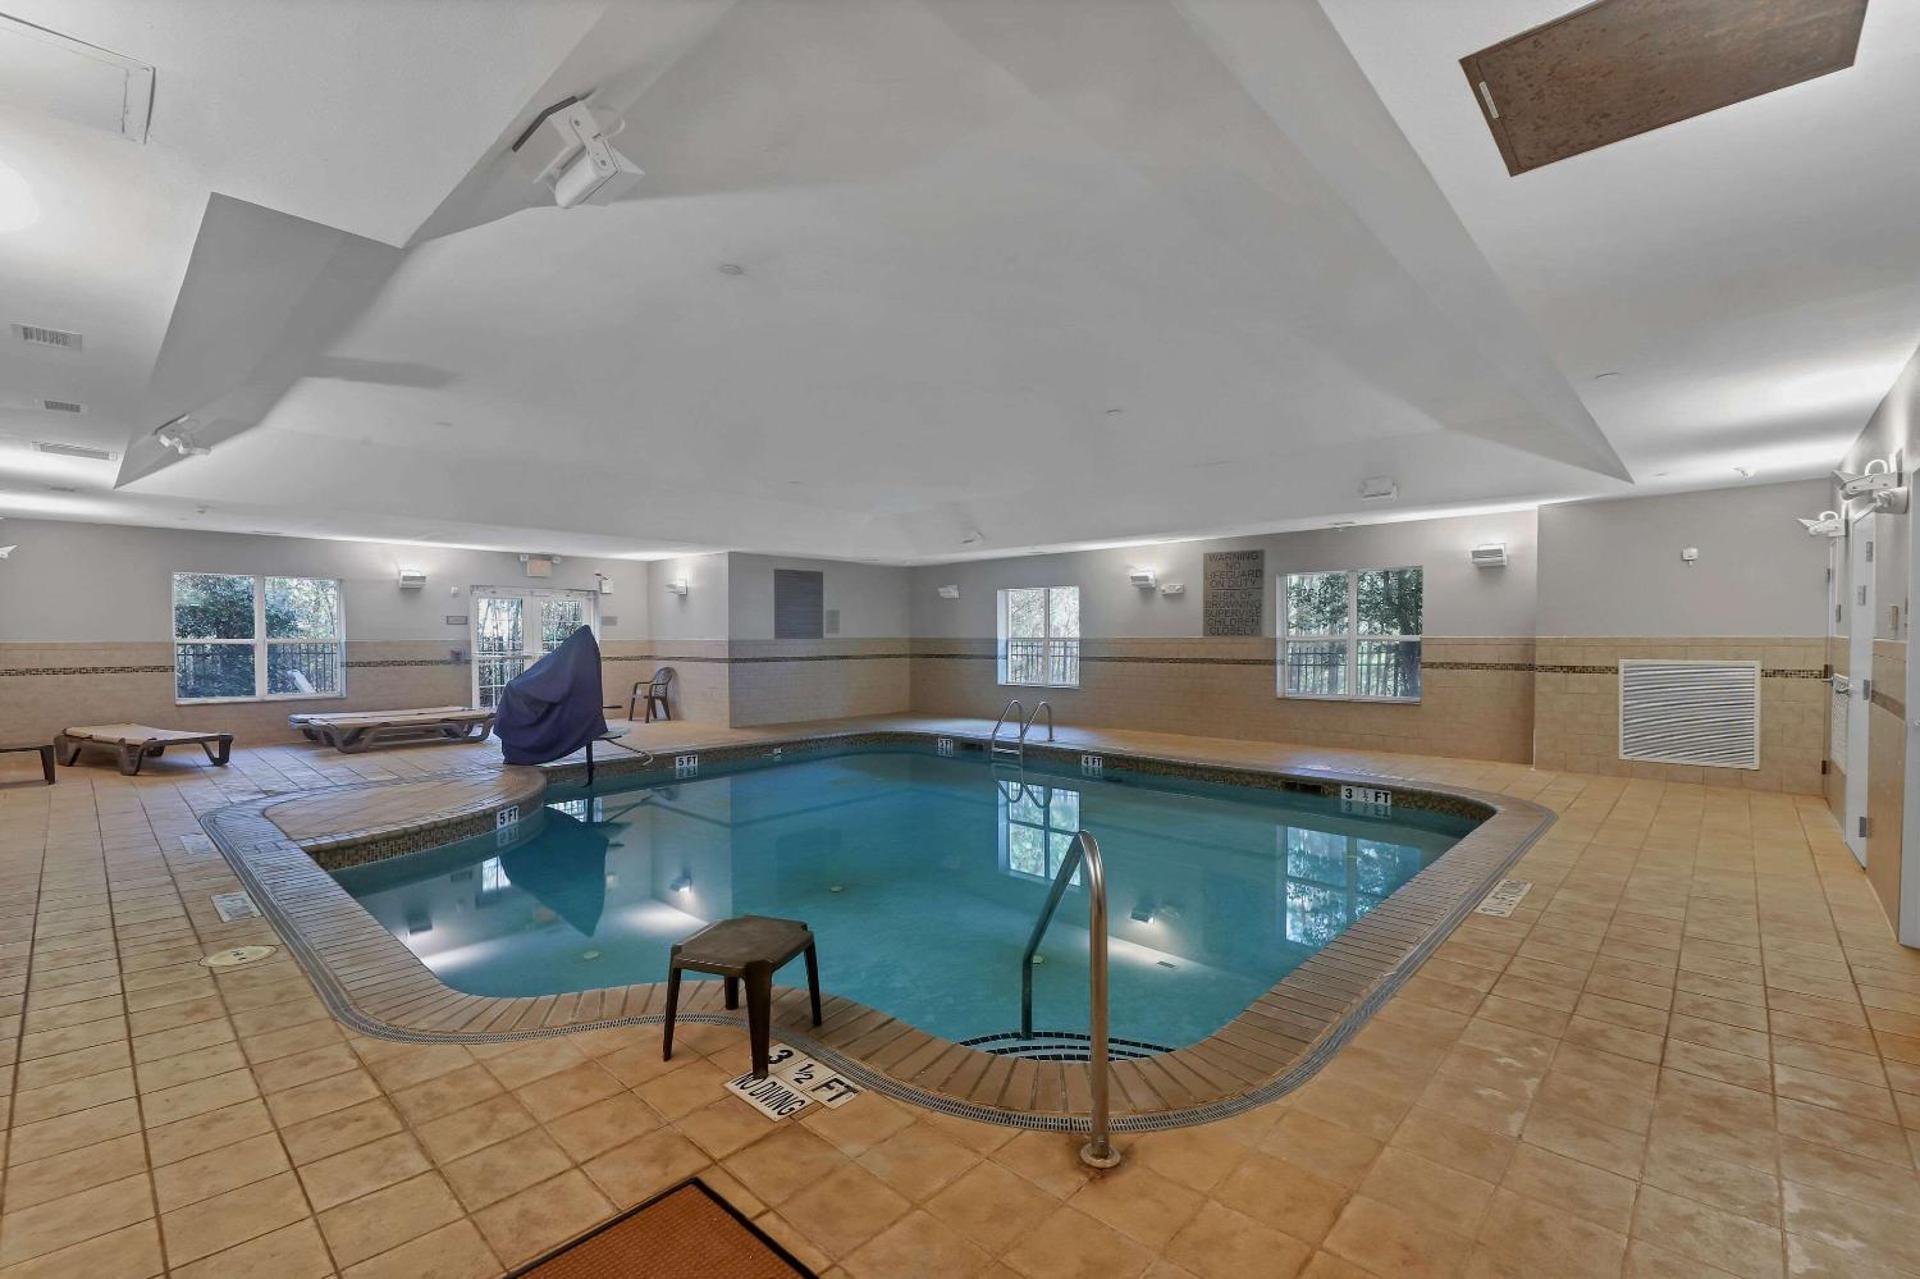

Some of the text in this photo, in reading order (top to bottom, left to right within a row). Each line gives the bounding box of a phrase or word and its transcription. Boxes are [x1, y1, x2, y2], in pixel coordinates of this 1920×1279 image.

[1208, 552, 1259, 561] WARNING
[1225, 562, 1241, 570] NO
[678, 756, 697, 766] 5 FT
[1092, 757, 1102, 766] FT
[1345, 788, 1353, 799] 3
[1375, 791, 1390, 803] FT
[499, 807, 518, 826] 5 FT
[768, 1049, 794, 1065] 3
[811, 1077, 860, 1103] FT
[748, 1081, 806, 1116] DIVING
